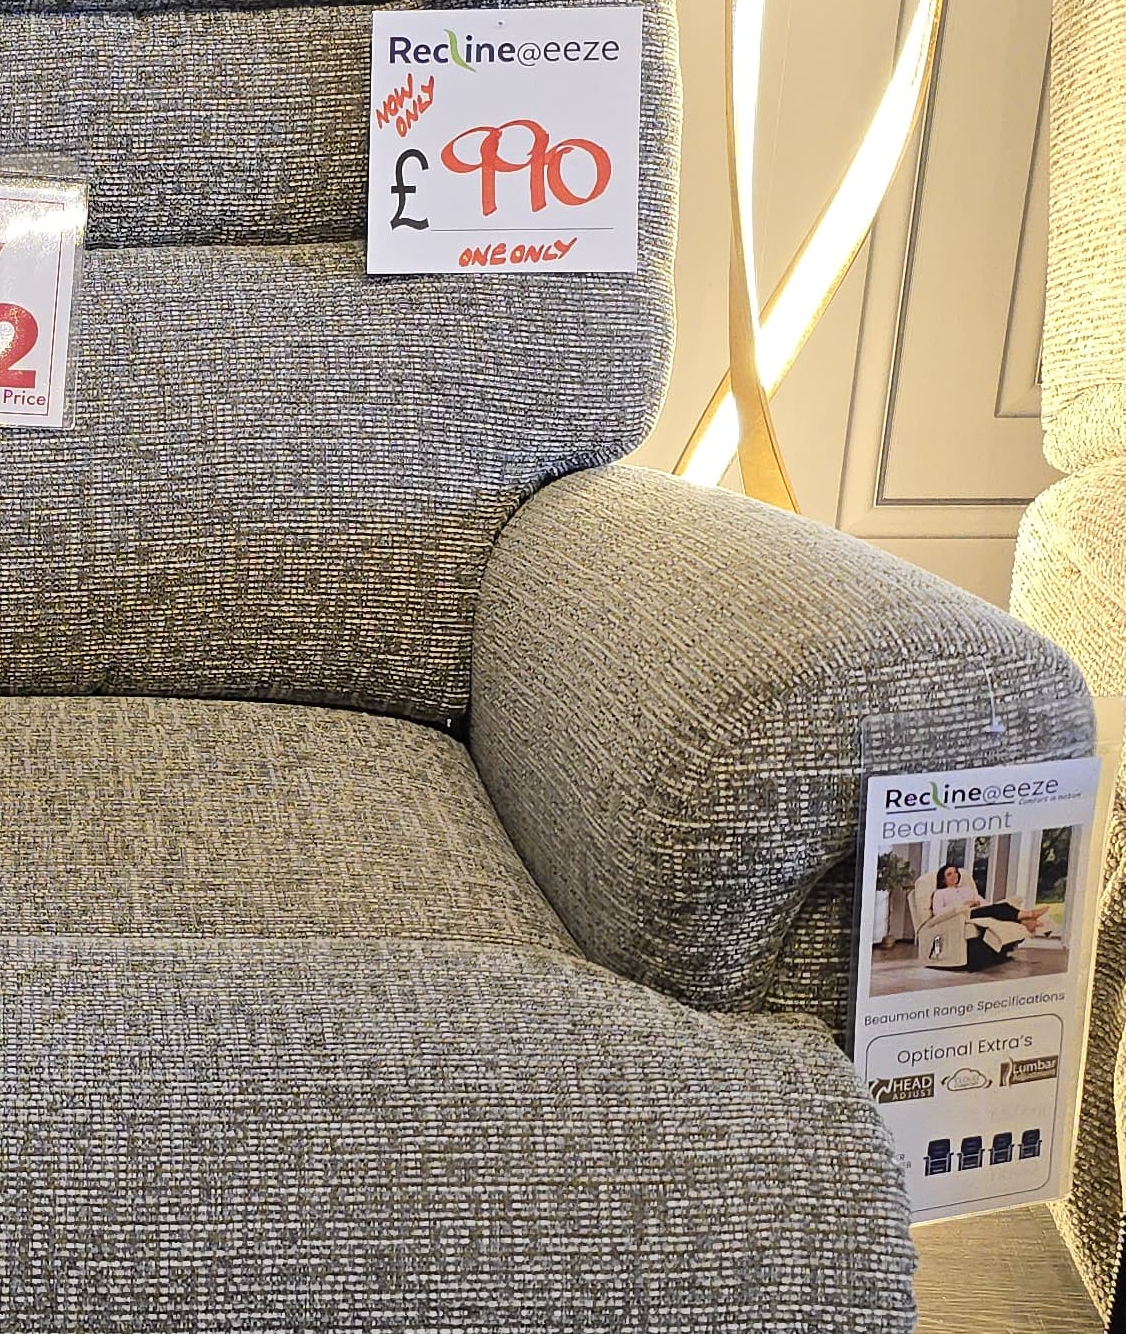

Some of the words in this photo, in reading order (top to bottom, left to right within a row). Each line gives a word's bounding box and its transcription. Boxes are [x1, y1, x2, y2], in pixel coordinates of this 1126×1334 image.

[389, 28, 620, 73] Recline@eeze
[375, 73, 413, 129] NOW
[396, 75, 435, 138] ONLY
[458, 242, 507, 267] ONE
[509, 237, 578, 264] ONLY
[3, 389, 47, 407] Price
[886, 779, 1059, 810] Recline@eeze
[882, 811, 1012, 839] Beaumont
[865, 1008, 929, 1026] Beaumont
[933, 1003, 973, 1017] Range
[977, 992, 1066, 1012] Specifications
[897, 1041, 972, 1066] Optional
[978, 1034, 1033, 1054] Extra's
[1013, 1059, 1057, 1075] Lumbar
[892, 1088, 932, 1101] ADJUST
[893, 1076, 932, 1092] HEAD
